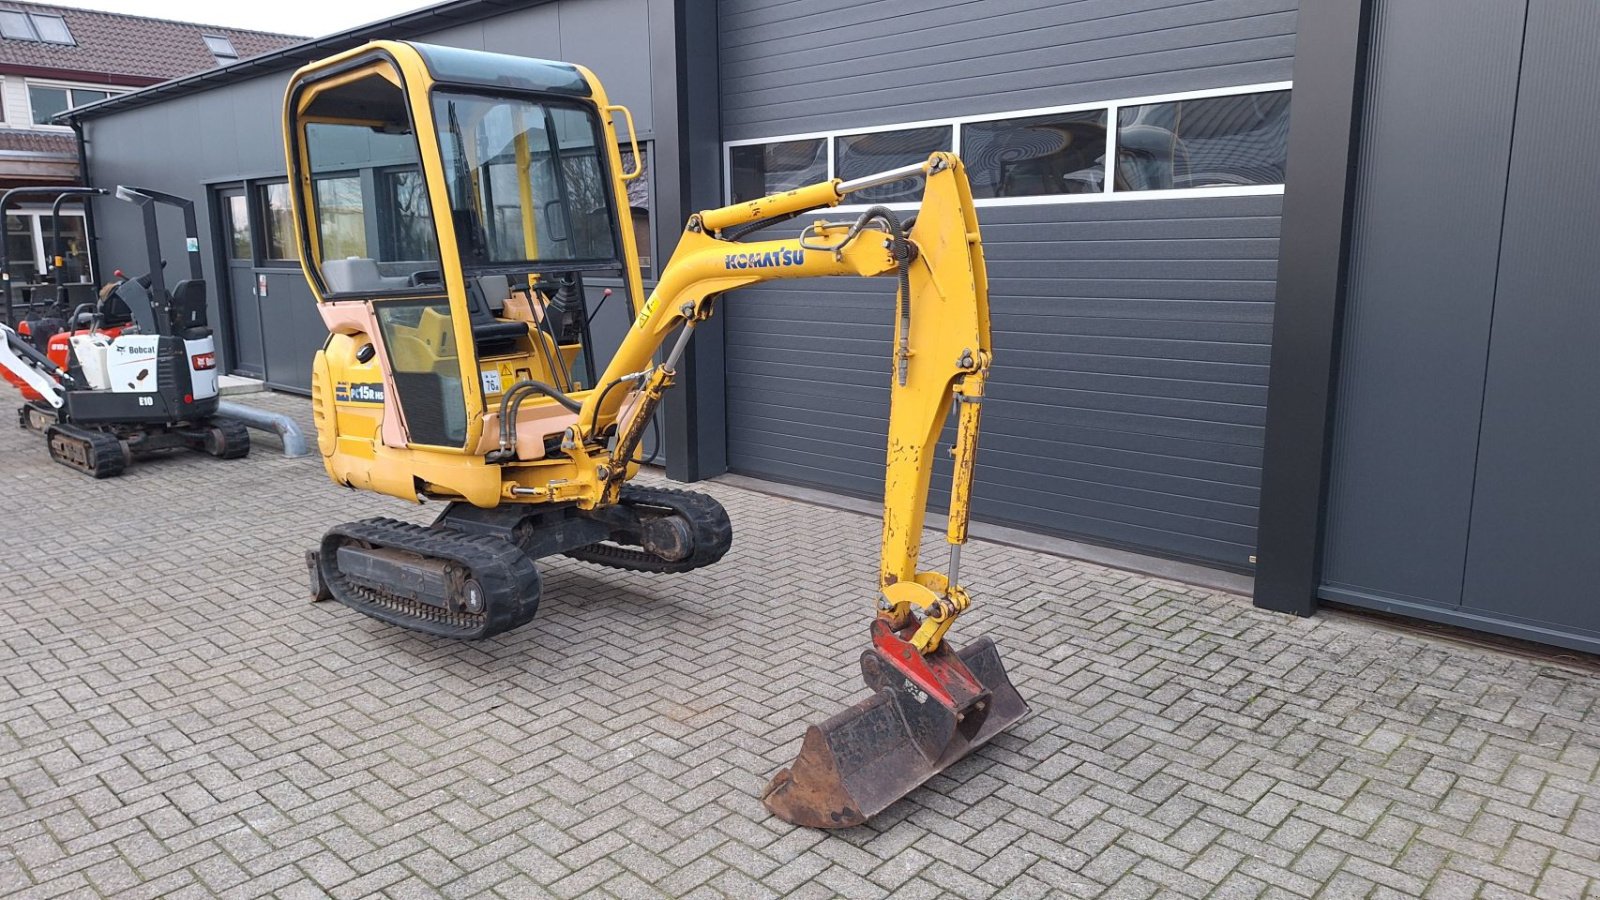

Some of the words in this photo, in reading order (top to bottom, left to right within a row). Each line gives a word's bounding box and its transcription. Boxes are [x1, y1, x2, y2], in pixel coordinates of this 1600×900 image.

[725, 246, 804, 269] KOMATSU
[129, 346, 155, 354] Bobcat
[139, 396, 153, 406] E10
